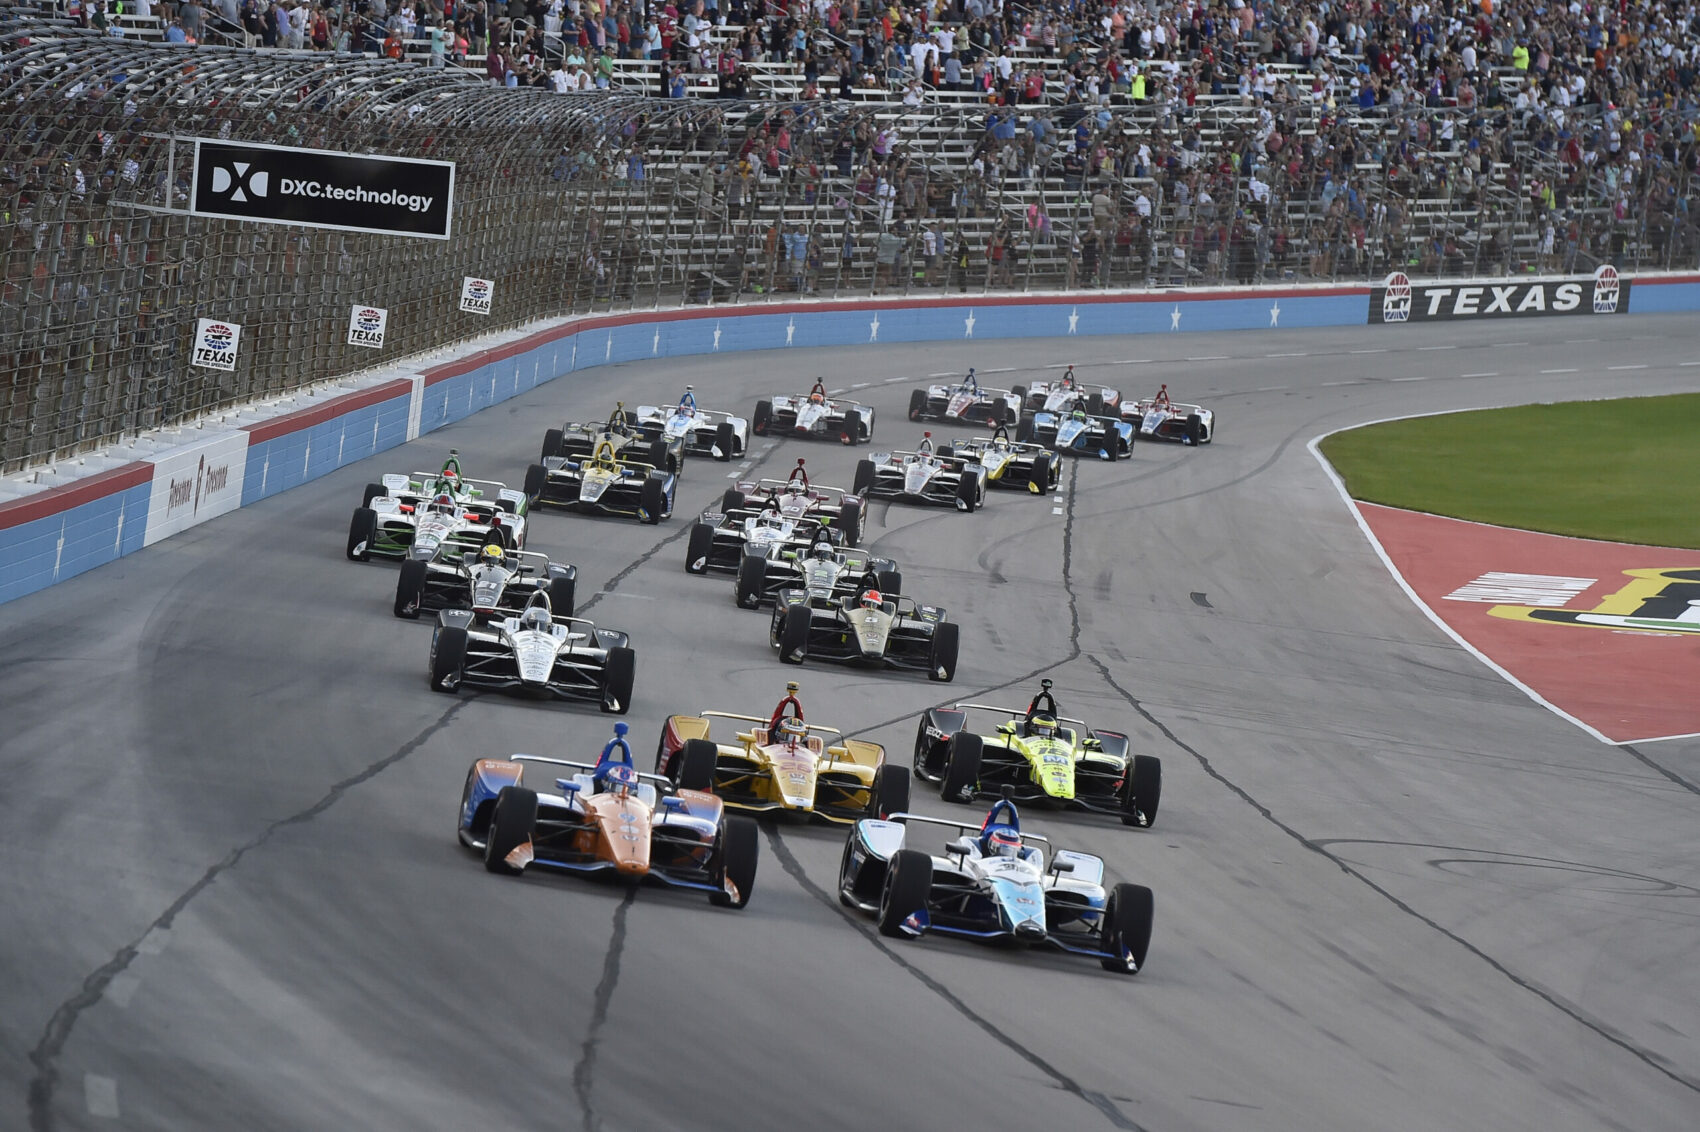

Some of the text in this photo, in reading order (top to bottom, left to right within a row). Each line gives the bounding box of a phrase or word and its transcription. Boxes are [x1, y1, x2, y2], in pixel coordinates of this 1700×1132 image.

[280, 178, 433, 212] DXC.technology
[463, 298, 490, 309] TEXAS
[1424, 284, 1583, 315] TEXAS
[351, 330, 383, 343] TEXAS
[197, 348, 235, 364] TEXAS
